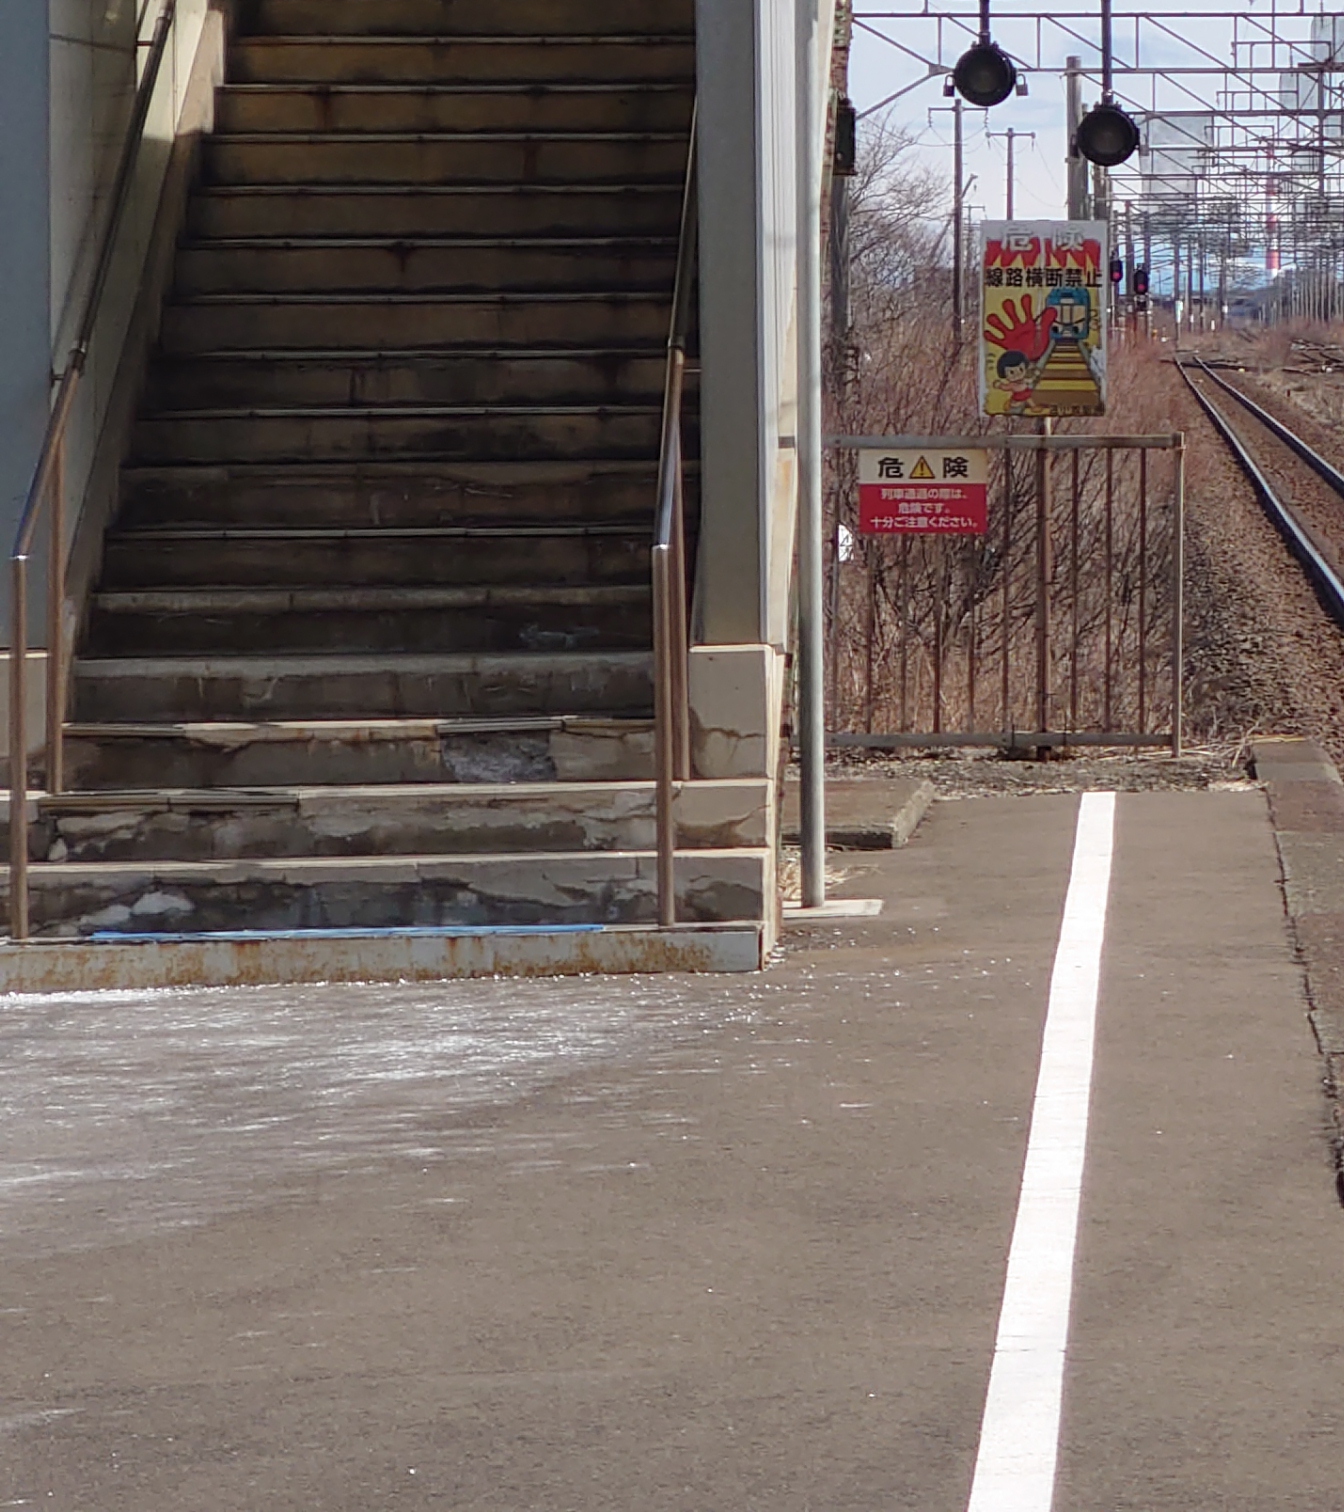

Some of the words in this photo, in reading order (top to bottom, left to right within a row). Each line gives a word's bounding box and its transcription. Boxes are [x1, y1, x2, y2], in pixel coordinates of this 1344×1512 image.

[984, 267, 1103, 288] 線路横断禁止
